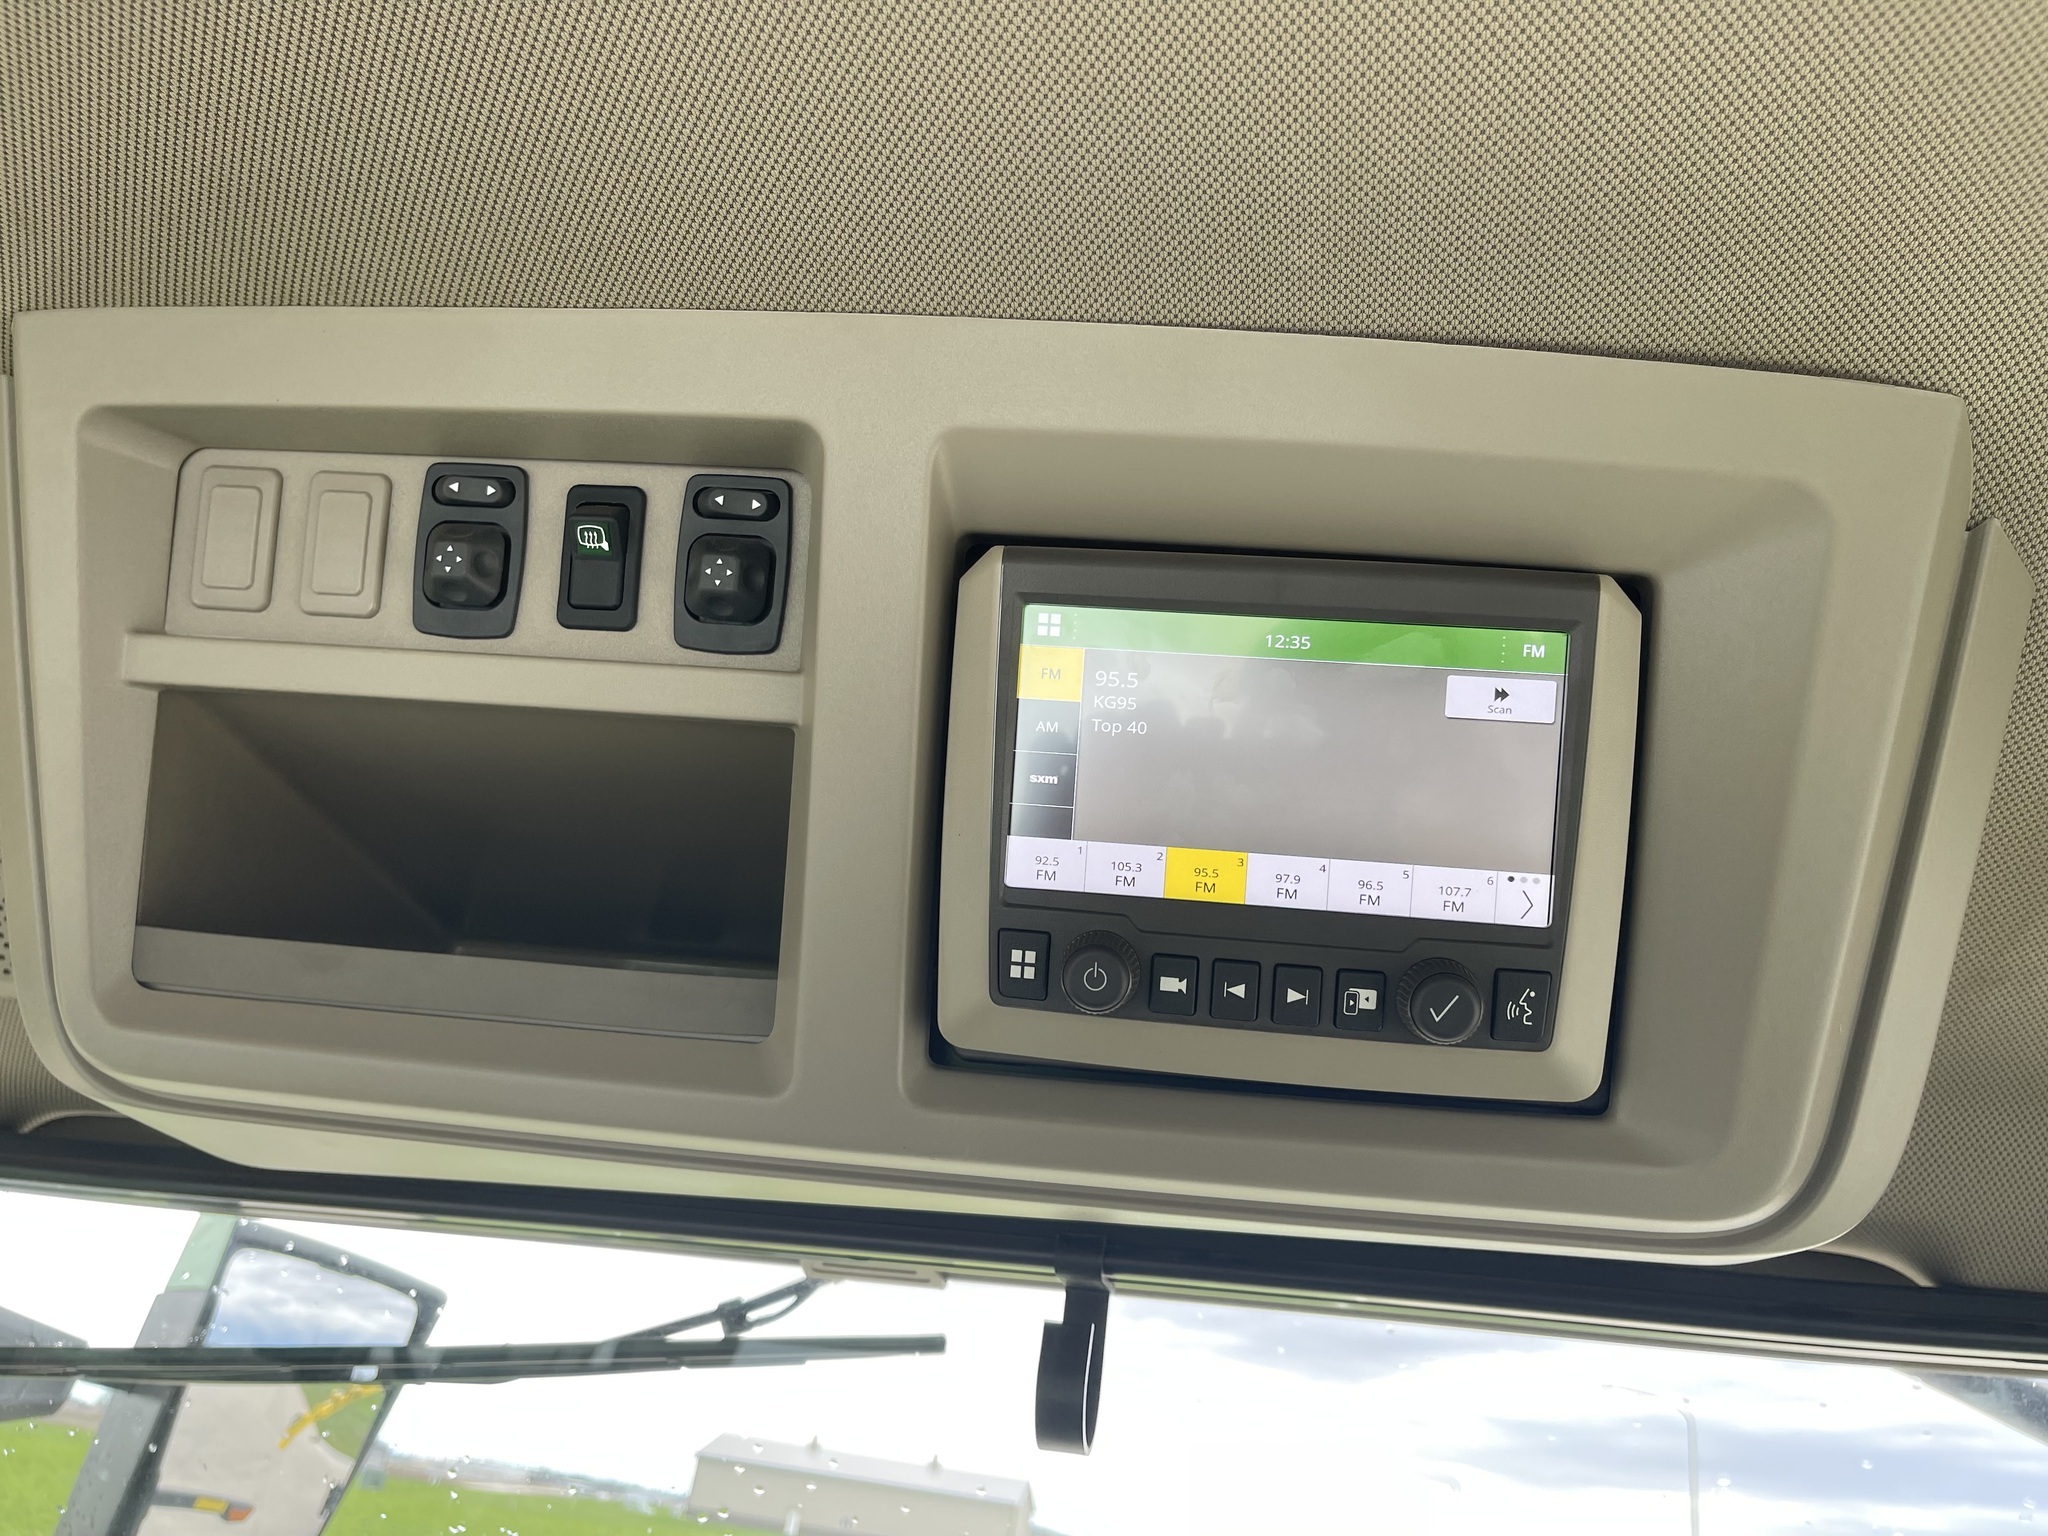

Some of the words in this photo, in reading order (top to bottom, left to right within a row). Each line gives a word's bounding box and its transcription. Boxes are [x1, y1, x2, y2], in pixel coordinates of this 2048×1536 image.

[1265, 634, 1311, 650] 12:35
[1522, 644, 1545, 658] FM
[1041, 667, 1061, 680] FM
[1095, 671, 1139, 688] 95.5
[1093, 695, 1137, 710] KG95
[1487, 704, 1512, 715] Scan
[1035, 721, 1058, 733] AM
[1092, 719, 1122, 736] Top
[1126, 721, 1147, 735] 40
[1029, 774, 1058, 785] sxm
[1035, 856, 1059, 867] 92.5
[1156, 852, 1163, 861] 2
[1237, 858, 1244, 867] 3
[1111, 861, 1142, 873] 105.3
[1194, 867, 1219, 879] 95.5
[1319, 864, 1326, 873] 4
[1036, 870, 1057, 882] FM
[1275, 873, 1301, 885] 97.9
[1403, 870, 1409, 879] 5
[1487, 876, 1494, 885] 6
[1115, 876, 1136, 888] FM
[1195, 882, 1216, 894] FM
[1357, 879, 1384, 891] 96.5
[1277, 888, 1298, 900] FM
[1438, 886, 1471, 897] 107.7
[1359, 894, 1380, 906] FM
[1443, 900, 1464, 913] FM
